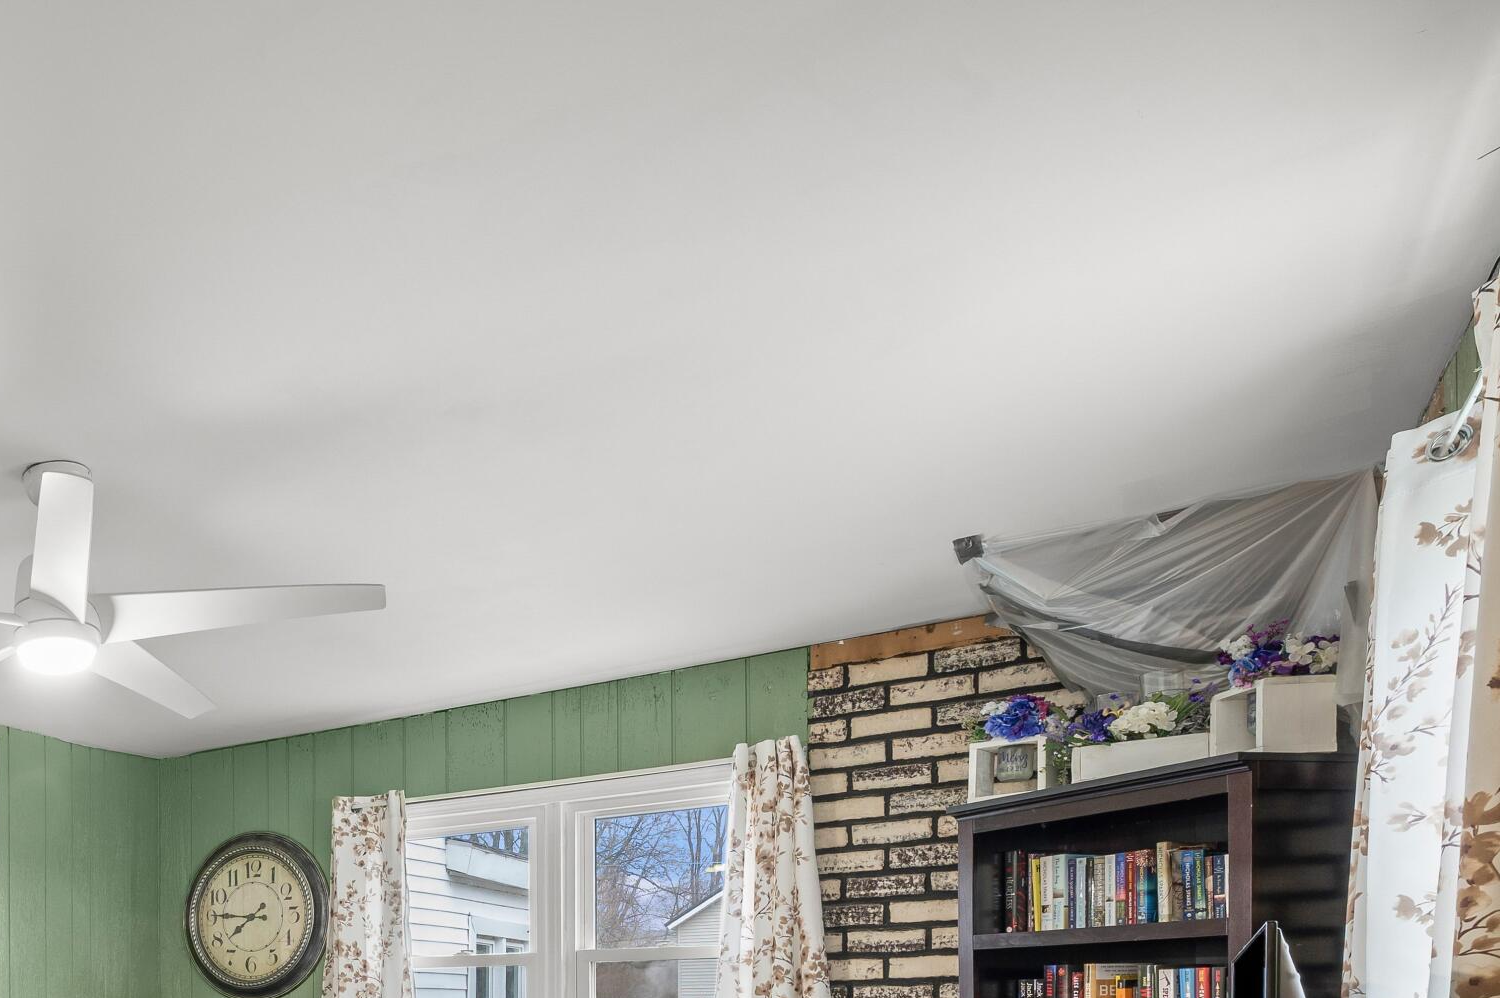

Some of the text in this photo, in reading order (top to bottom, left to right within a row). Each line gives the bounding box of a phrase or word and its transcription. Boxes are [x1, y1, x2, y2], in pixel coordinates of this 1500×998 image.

[228, 869, 238, 887] 11
[245, 859, 262, 879] 12
[271, 866, 276, 883] 1
[210, 887, 227, 906] 10
[280, 882, 293, 900] 2
[206, 909, 218, 926] 9
[288, 905, 300, 924] 3
[211, 931, 224, 947] 8
[245, 955, 257, 973] 6
[267, 948, 278, 966] 5
